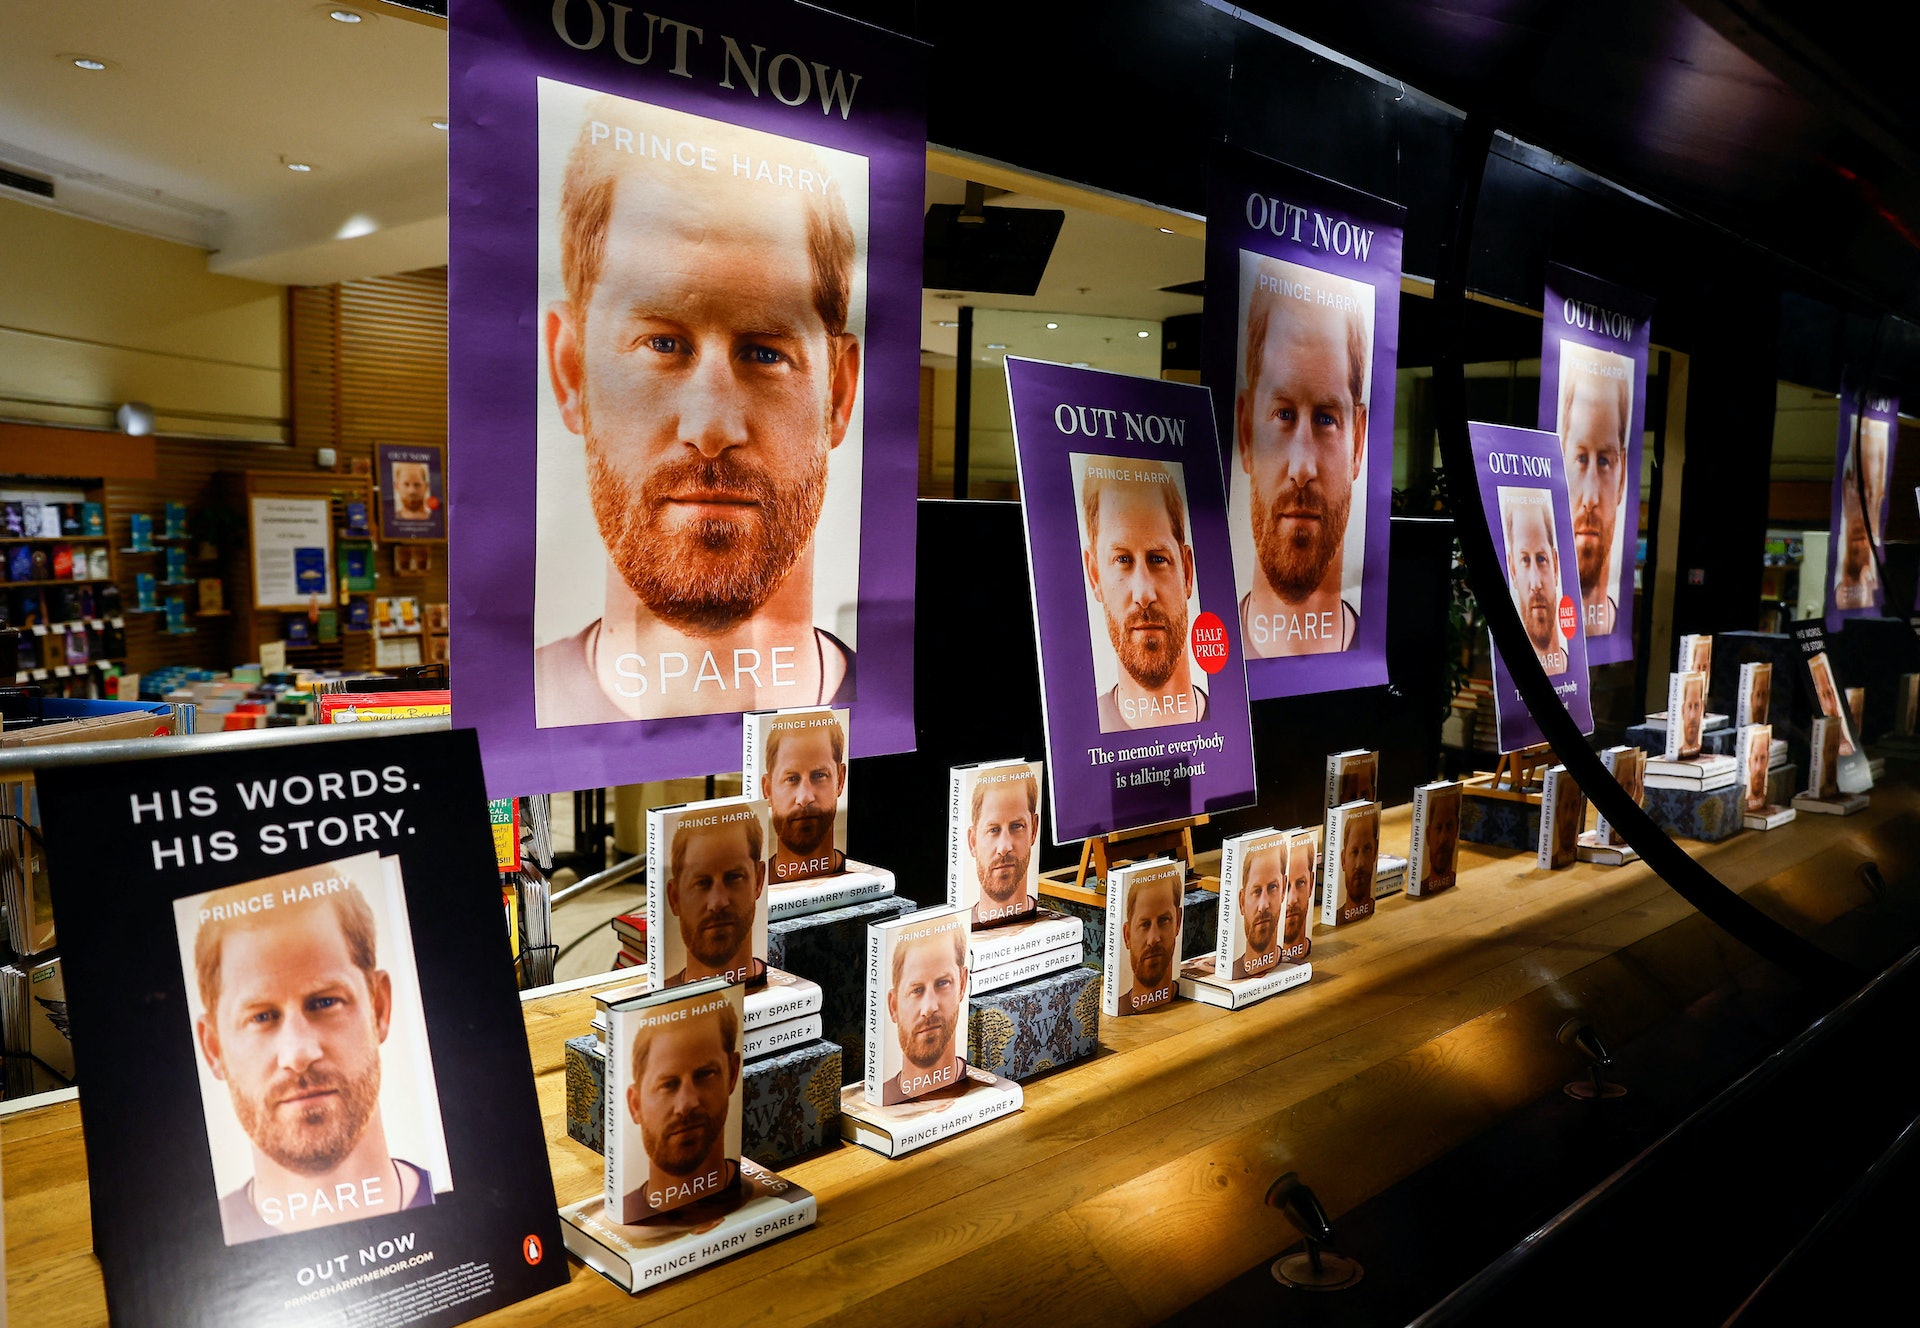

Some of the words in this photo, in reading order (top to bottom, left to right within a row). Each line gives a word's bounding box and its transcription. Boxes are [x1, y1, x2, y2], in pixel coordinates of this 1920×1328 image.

[551, 0, 703, 79] OUT
[719, 34, 862, 121] NOW
[590, 120, 718, 172] PRINCE
[732, 152, 833, 196] HARRY
[1246, 192, 1307, 242] OUT
[1311, 212, 1374, 263] NOW
[1259, 274, 1311, 302] PRINCE
[1316, 288, 1360, 313] HARRY
[1563, 298, 1597, 332] OUT
[1599, 310, 1636, 343] NOW
[1054, 403, 1117, 440] OUT
[1121, 411, 1186, 447] NOW
[1088, 466, 1131, 482] PRINCE
[1135, 470, 1172, 485] HARRY
[1489, 451, 1519, 475] OUT
[1520, 455, 1551, 478] NOW
[1560, 607, 1574, 617] HALF
[1560, 618, 1576, 628] PRICE
[1582, 604, 1604, 626] ARE
[1196, 628, 1223, 643] HALF
[1253, 611, 1333, 644] SPARE
[1195, 642, 1227, 659] PRICE
[1541, 653, 1561, 668] ARE
[614, 645, 797, 699] SPARE
[1124, 693, 1188, 721] SPARE
[771, 719, 807, 731] PRINCE
[809, 716, 840, 728] HARRY
[1088, 745, 1114, 766] The
[1118, 742, 1166, 761] memoir
[1168, 732, 1225, 758] everybody
[977, 774, 1007, 785] PRINCE
[1009, 770, 1034, 781] HARRY
[1116, 771, 1127, 789] is
[1129, 766, 1171, 792] talking
[1174, 761, 1206, 782] about
[130, 785, 219, 826] HIS
[236, 765, 421, 811] WORDS.
[487, 798, 507, 808] NTH
[490, 813, 510, 824] IZER
[677, 816, 718, 830] PRINCE
[721, 810, 756, 824] HARRY
[151, 831, 240, 872] HIS
[260, 808, 417, 857] STORY.
[1246, 843, 1267, 853] PRINCE
[1268, 838, 1287, 849] HARRY
[1296, 837, 1313, 846] HARRY
[777, 857, 829, 878] SPARE
[1131, 874, 1156, 885] PRINCE
[1158, 870, 1179, 880] HARRY
[1225, 848, 1233, 886] PRINCE
[1428, 877, 1450, 890] SPARE
[199, 892, 276, 926] PRINCE
[282, 875, 355, 907] HARRY
[771, 899, 808, 913] PRINCE
[812, 891, 844, 905] HARRY
[850, 884, 880, 898] SPARE
[979, 902, 1023, 924] SPARE
[1344, 903, 1369, 920] SPARE
[898, 928, 931, 943] PRINCE
[934, 921, 963, 935] HARRY
[980, 947, 1011, 962] PRINCE
[1014, 939, 1042, 954] HARRY
[1045, 931, 1071, 945] SPARE
[1244, 951, 1274, 973] SPARE
[1282, 943, 1304, 958] PARE
[978, 971, 1010, 987] PRINCE
[1012, 963, 1041, 978] HARRY
[1045, 954, 1070, 969] SPARE
[1132, 987, 1169, 1009] SPARE
[1238, 988, 1261, 1001] PRINCE
[1262, 981, 1282, 992] HARRY
[1285, 972, 1303, 985] SPARE
[639, 1009, 687, 1029] PRINCE
[691, 998, 733, 1017] HARRY
[743, 1010, 761, 1023] RRY
[769, 999, 803, 1017] SPARE
[743, 1040, 762, 1053] RRY
[769, 1028, 803, 1046] SPARE
[868, 1041, 876, 1083] SPARE
[901, 1065, 951, 1095] SPARE
[607, 1085, 615, 1139] HARRY
[901, 1126, 938, 1148] PRINCE
[941, 1113, 973, 1132] HARRY
[979, 1100, 1008, 1119] SPARE
[261, 1176, 386, 1227] SPARE
[649, 1170, 719, 1210] SPARE
[296, 1254, 349, 1287] OUT
[358, 1232, 416, 1267] NOW
[644, 1251, 697, 1280] PRINCE
[702, 1232, 747, 1258] HARRY
[754, 1213, 795, 1238] SPARE
[284, 1251, 435, 1310] PRINCEHARRYMEMOIR.COM
